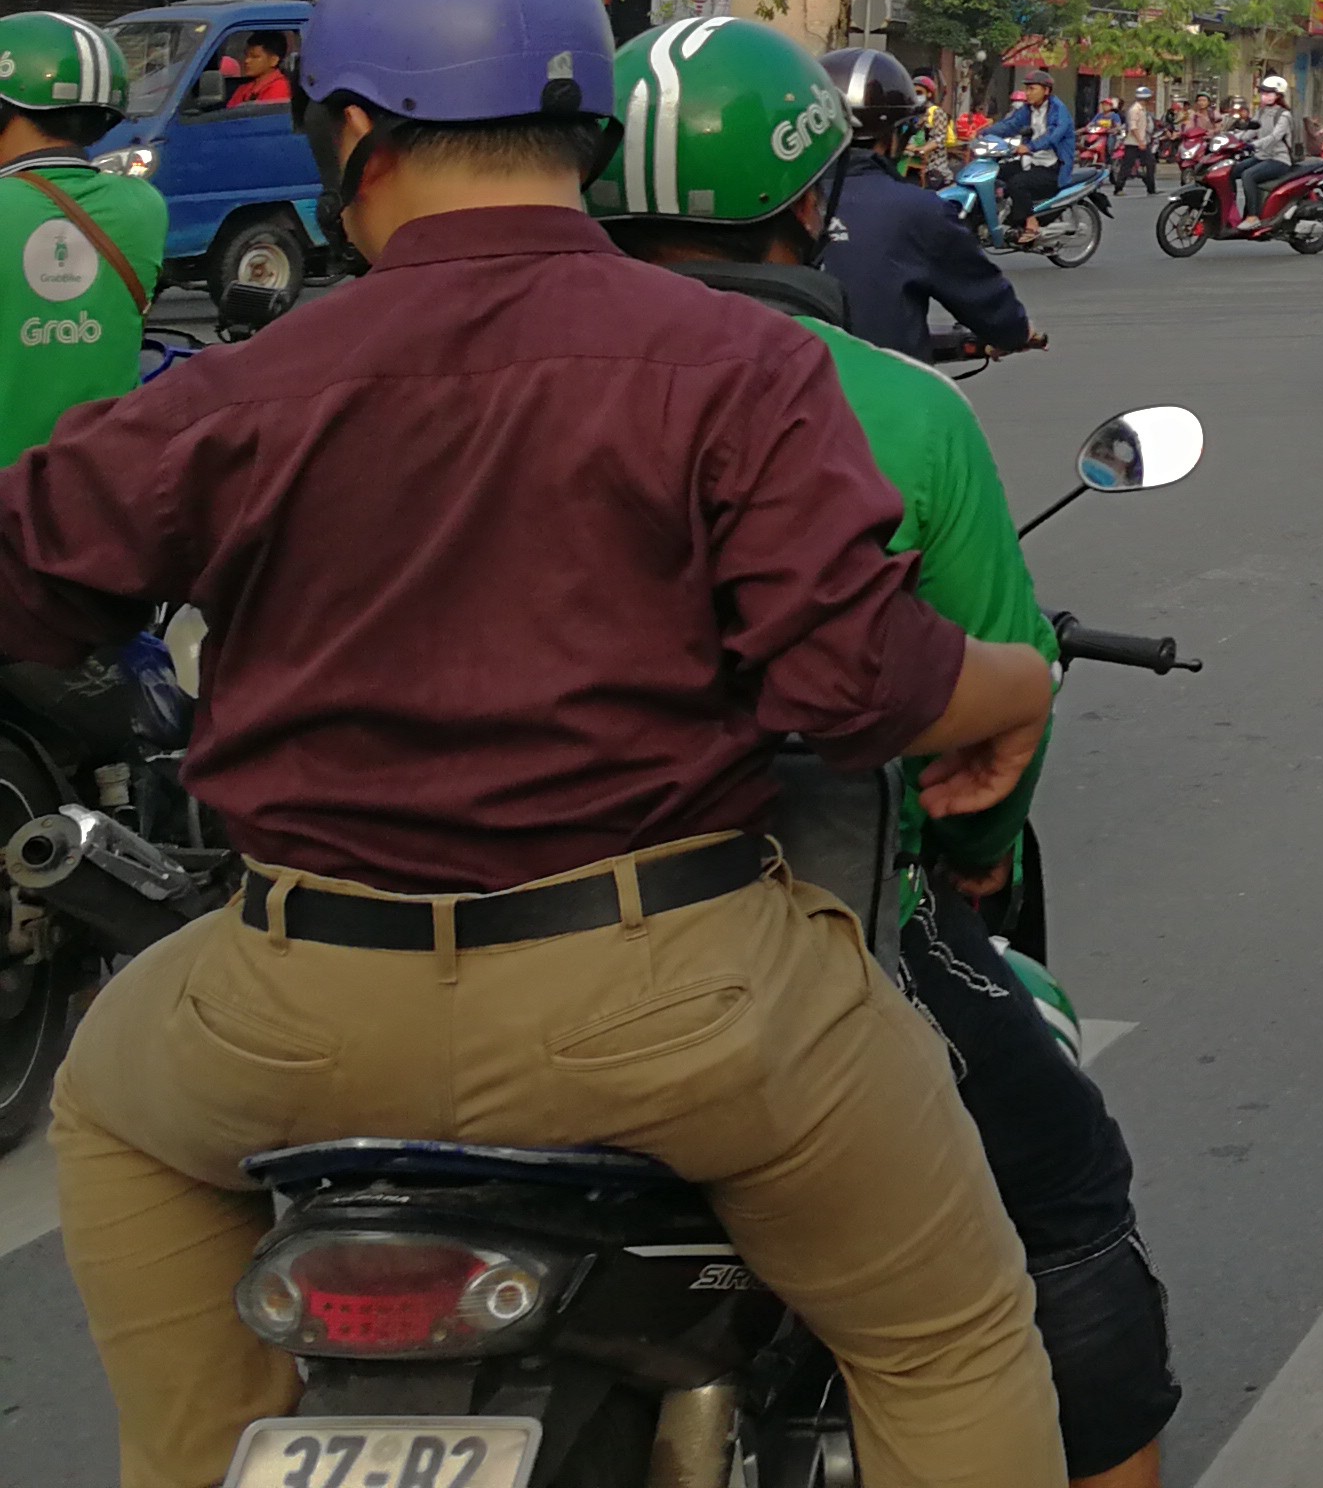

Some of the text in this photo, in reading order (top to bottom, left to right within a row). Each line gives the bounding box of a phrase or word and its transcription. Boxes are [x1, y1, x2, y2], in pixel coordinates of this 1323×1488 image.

[771, 83, 841, 162] Grab
[40, 272, 82, 284] GrabBike
[20, 311, 103, 347] Grab
